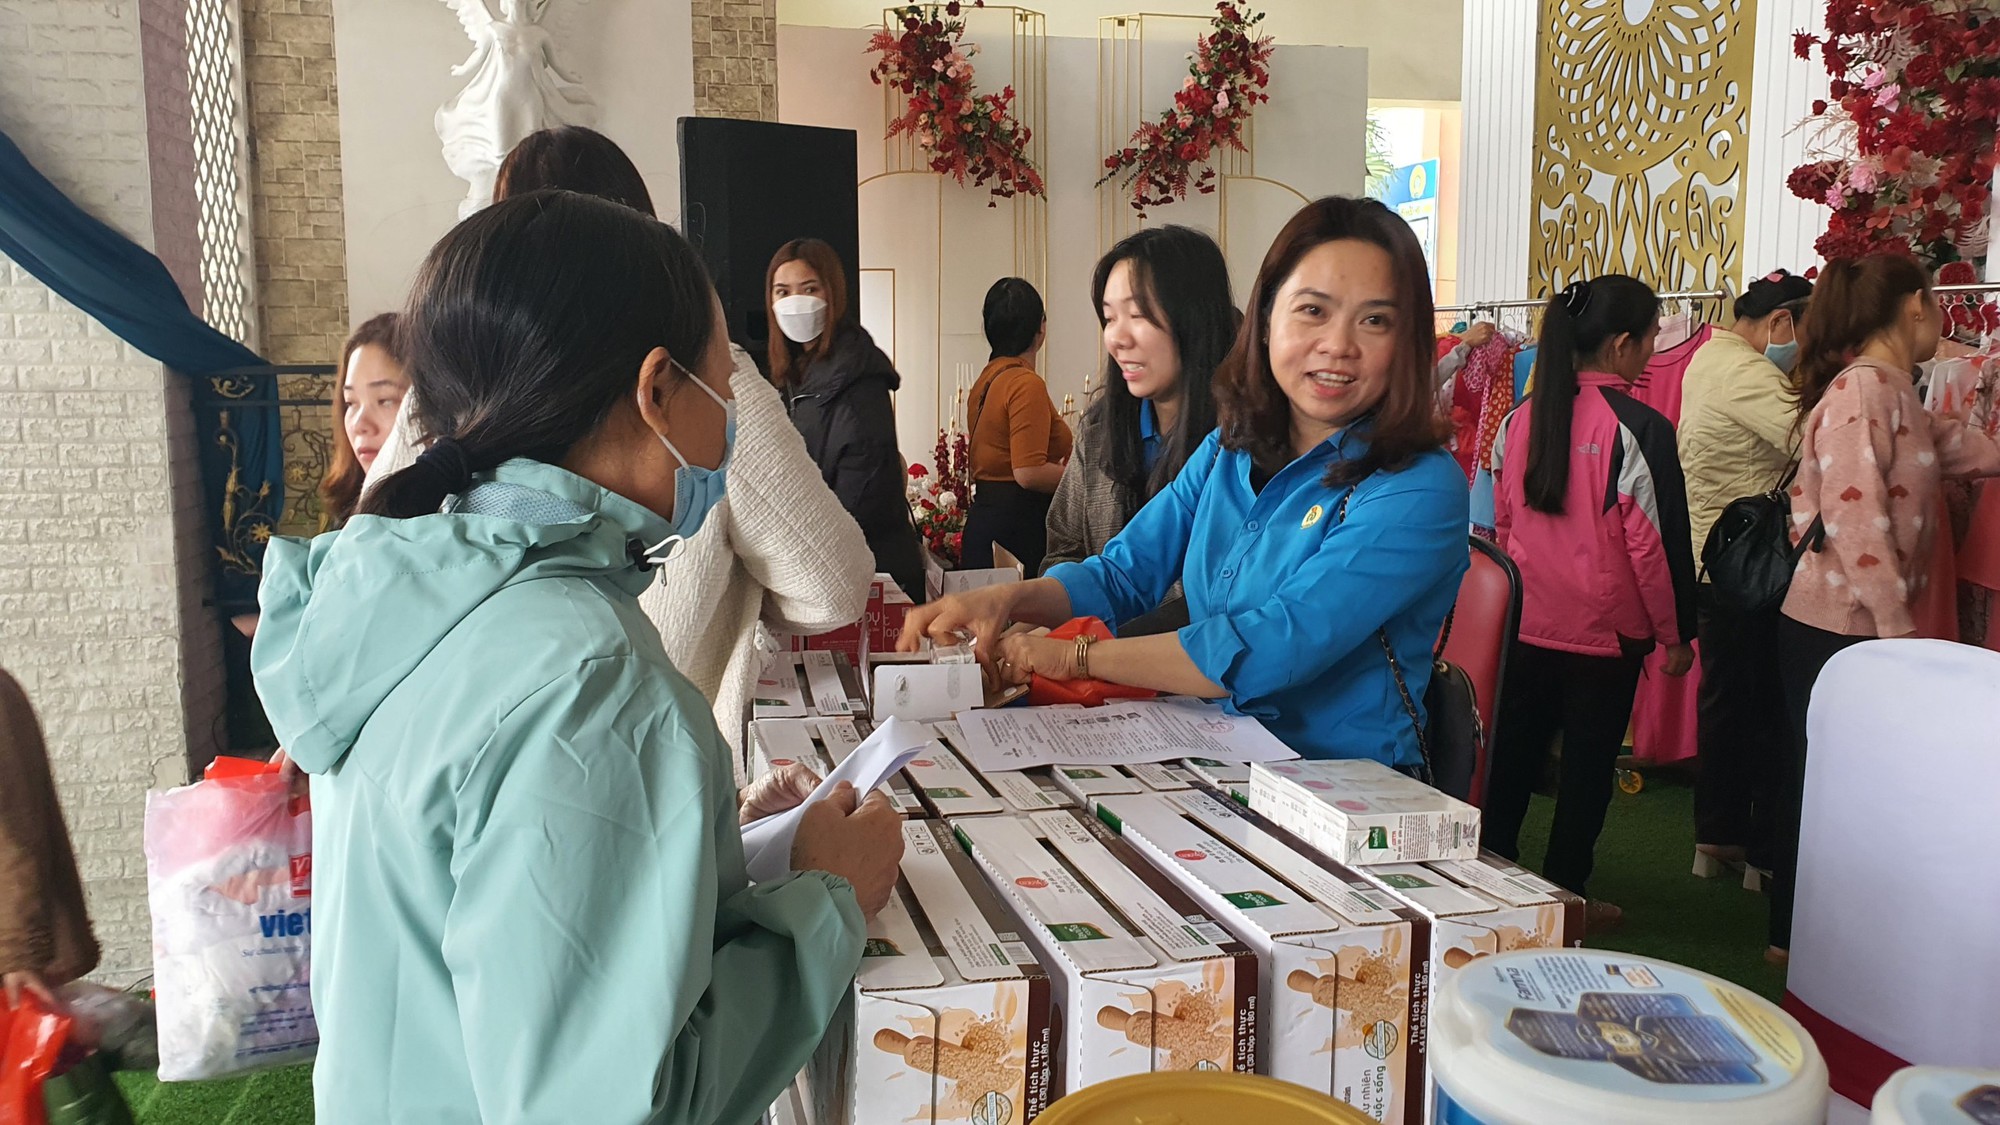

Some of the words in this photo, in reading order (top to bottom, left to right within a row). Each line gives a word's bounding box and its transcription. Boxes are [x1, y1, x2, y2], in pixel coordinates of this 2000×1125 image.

[1412, 972, 1422, 998] thực
[1421, 974, 1429, 989] 180
[1248, 996, 1257, 1009] ml)
[1411, 1001, 1420, 1022] tích
[1238, 1008, 1248, 1035] thực
[1247, 1010, 1255, 1026] 180
[1042, 1027, 1050, 1042] ml)
[1247, 1035, 1256, 1052] hộp
[1030, 1040, 1041, 1068] thực
[1237, 1038, 1247, 1061] tích
[1029, 1071, 1039, 1094] tích
[1361, 1069, 1372, 1100] nhiên
[1372, 1065, 1386, 1094] sống
